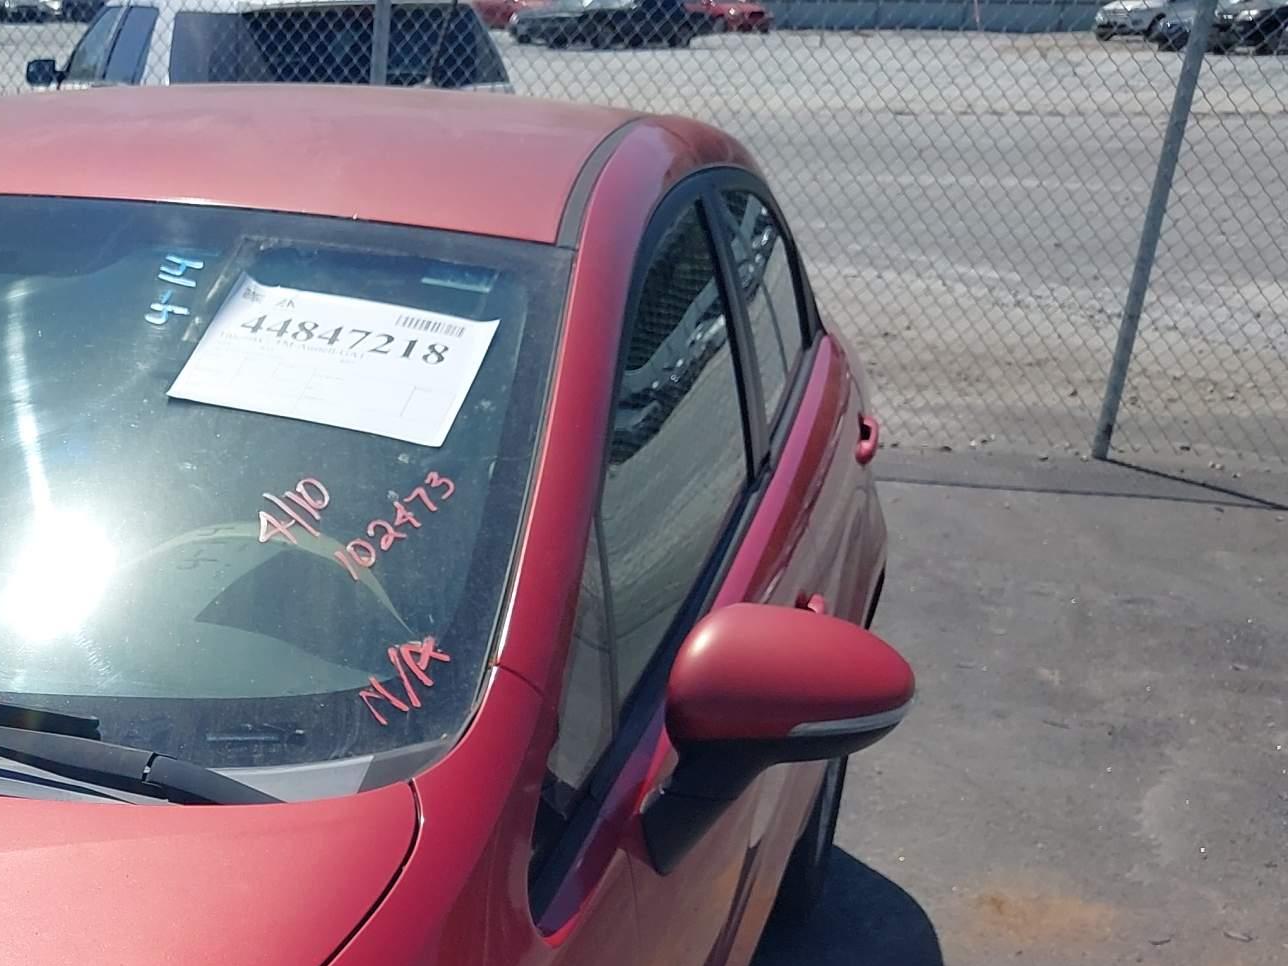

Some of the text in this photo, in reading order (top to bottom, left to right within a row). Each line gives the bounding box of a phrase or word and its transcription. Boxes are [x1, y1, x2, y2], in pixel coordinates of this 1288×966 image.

[240, 313, 450, 366] 44847218
[258, 476, 331, 545] 4/10
[334, 471, 457, 581] 102473
[359, 635, 451, 726] N/A
